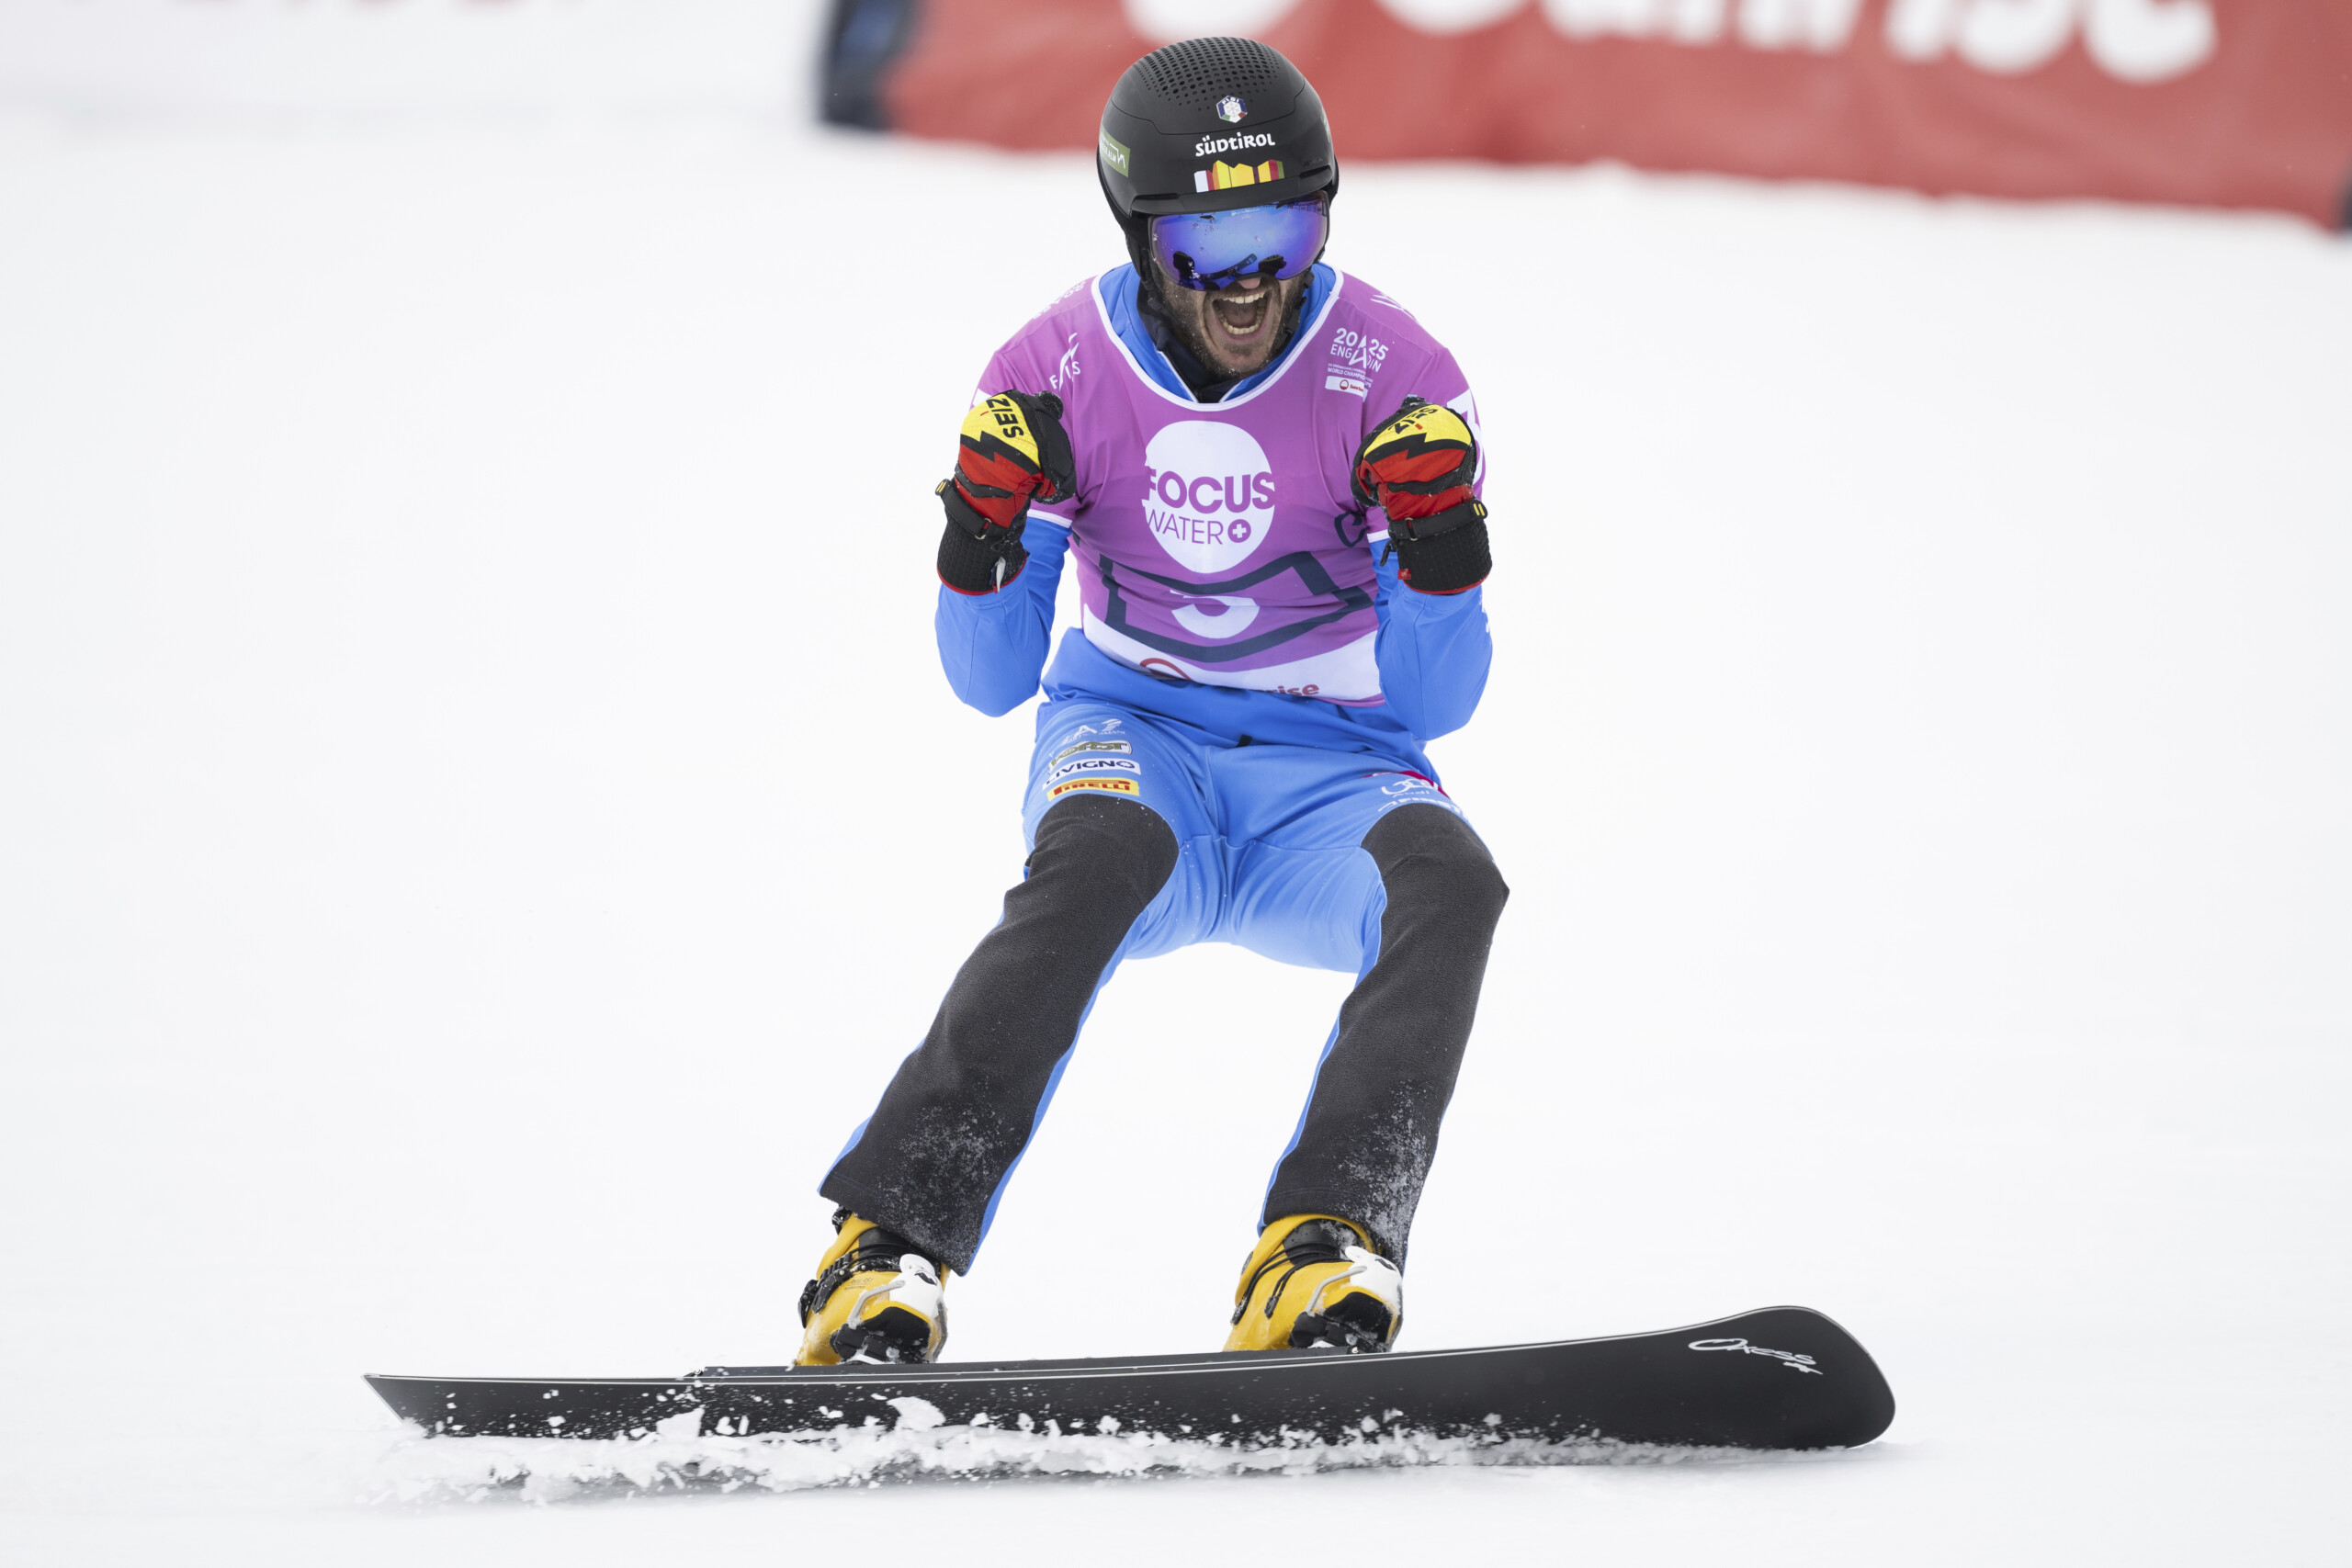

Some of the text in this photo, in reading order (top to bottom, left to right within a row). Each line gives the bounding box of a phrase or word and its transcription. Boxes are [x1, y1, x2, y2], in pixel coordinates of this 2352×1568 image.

[986, 398, 1024, 438] SEIZ
[1046, 761, 1136, 785] LIVIGNO
[1053, 779, 1131, 795] PIRELLI
